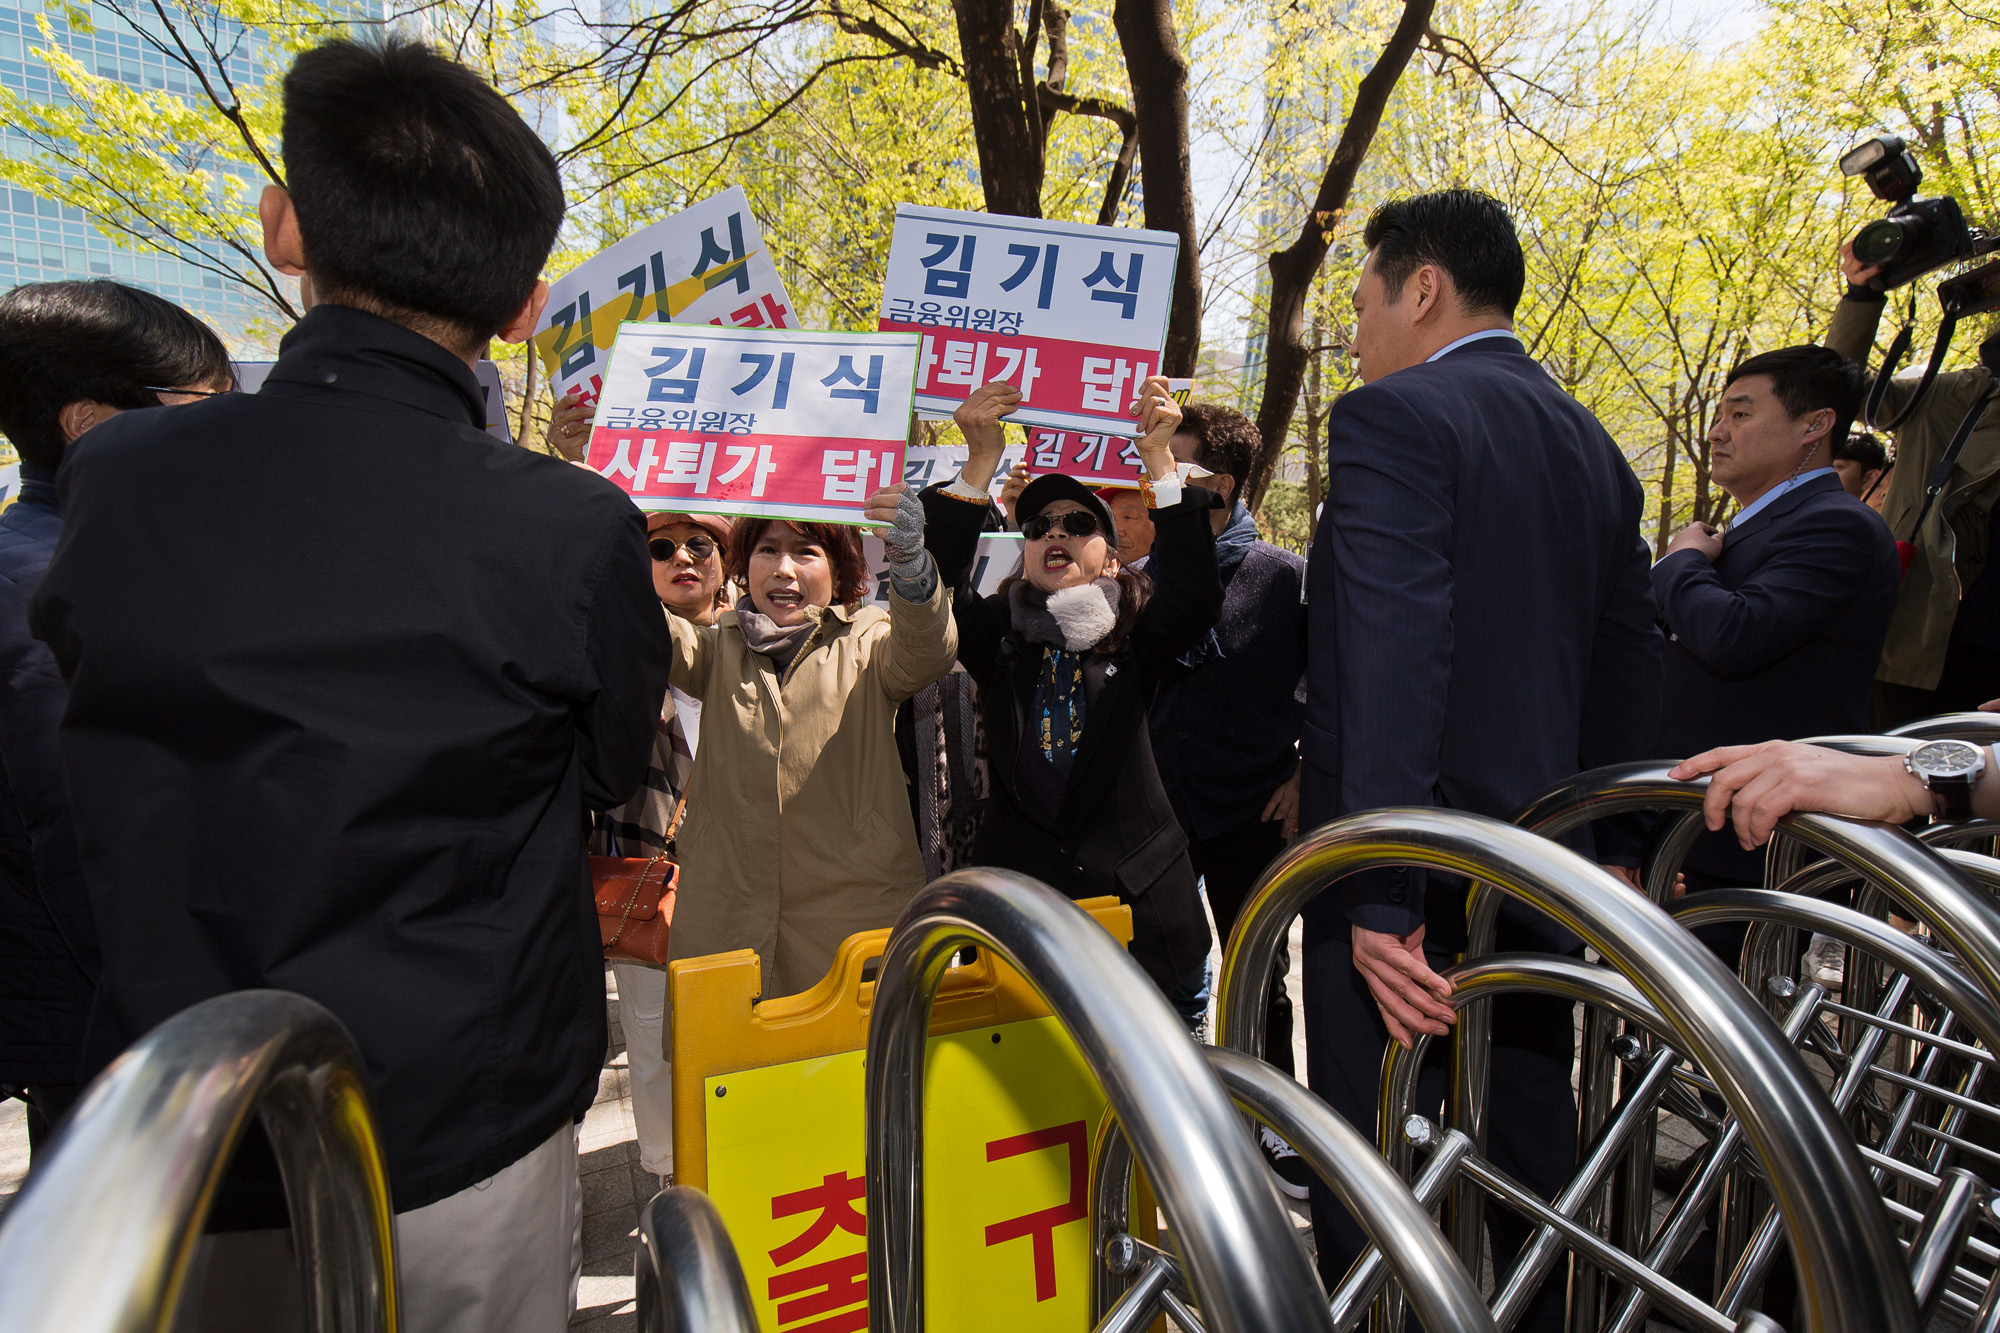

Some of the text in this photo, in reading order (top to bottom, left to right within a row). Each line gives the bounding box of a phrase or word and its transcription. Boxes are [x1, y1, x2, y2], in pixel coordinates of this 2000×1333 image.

[888, 298, 1024, 337] 금융위원장
[1081, 356, 1149, 413] 답!
[606, 406, 757, 436] 금융위원장
[600, 438, 777, 497] 사퇴가
